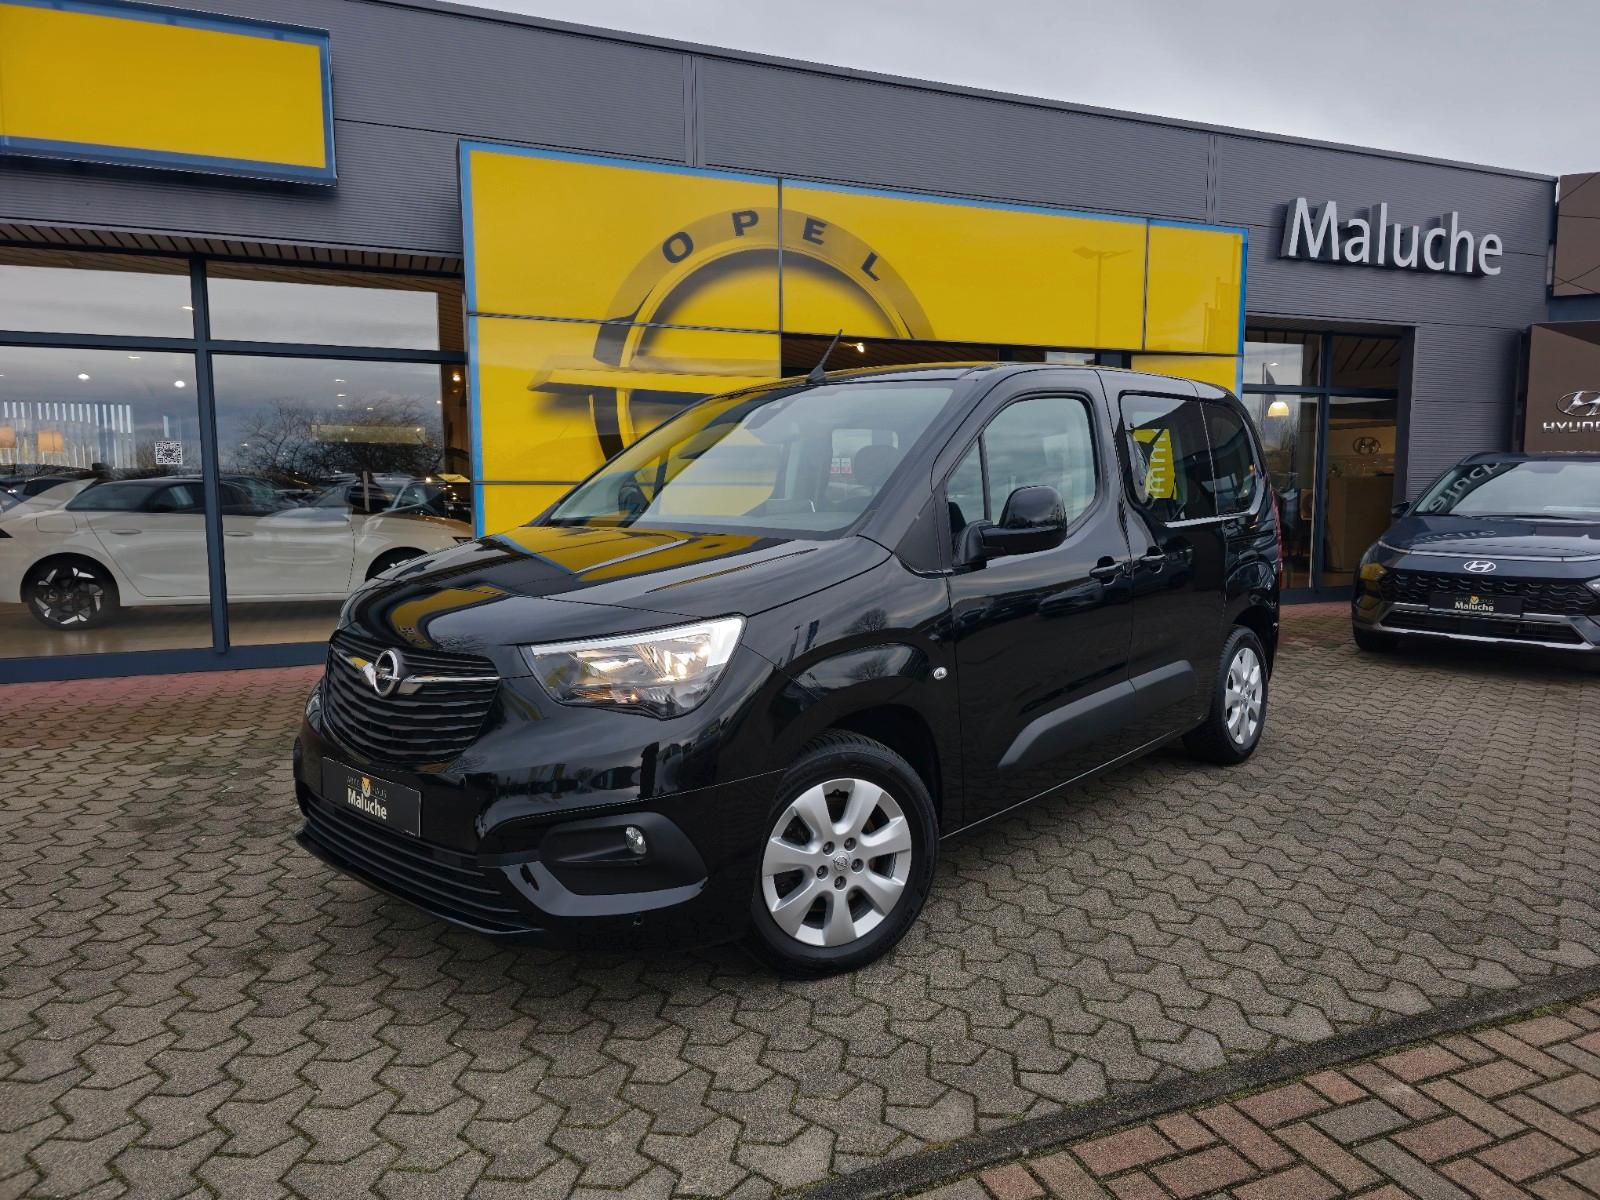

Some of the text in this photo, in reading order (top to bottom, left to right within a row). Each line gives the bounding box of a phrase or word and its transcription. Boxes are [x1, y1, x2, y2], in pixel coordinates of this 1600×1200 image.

[662, 210, 880, 282] OPEL
[1285, 197, 1503, 275] Maluche
[1454, 600, 1495, 613] Maluche
[346, 786, 388, 820] Maluche
